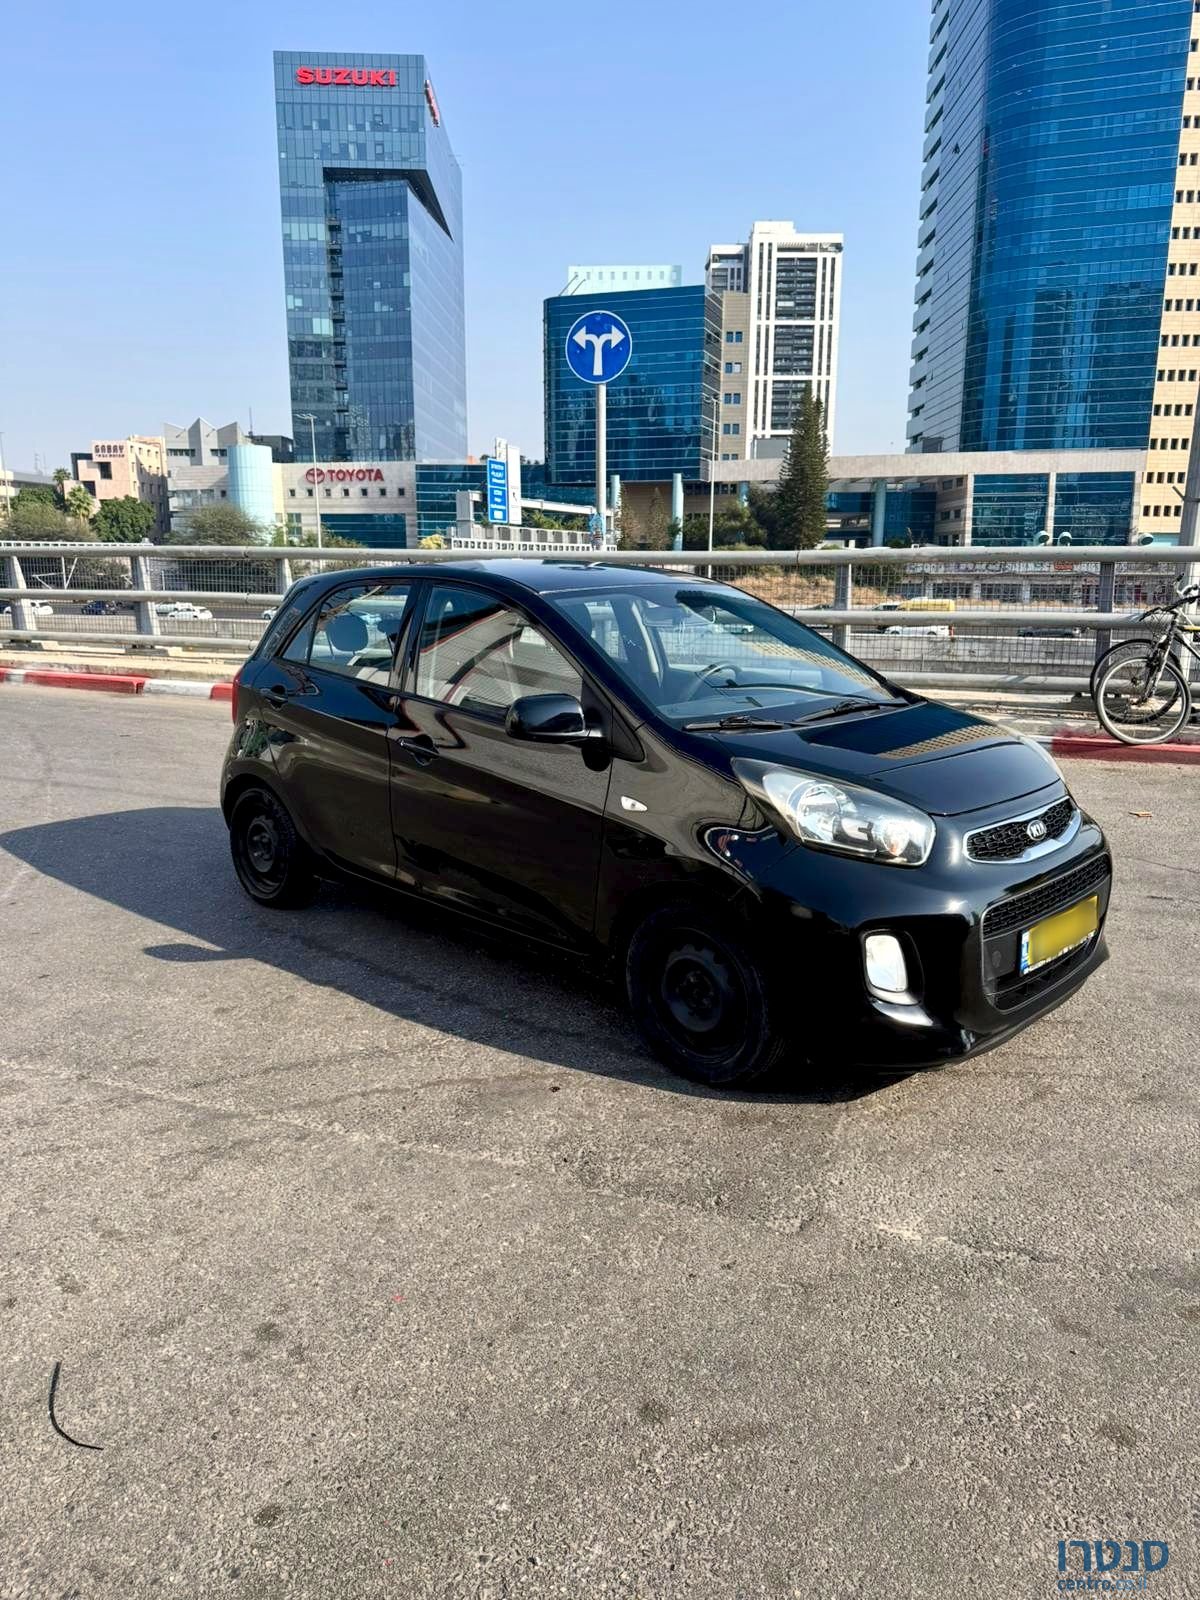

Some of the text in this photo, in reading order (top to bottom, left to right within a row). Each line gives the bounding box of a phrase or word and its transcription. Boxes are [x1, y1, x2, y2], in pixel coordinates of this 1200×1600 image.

[296, 66, 397, 87] SUZUKI
[327, 468, 384, 482] TOYOTA
[1030, 822, 1047, 838] KIA
